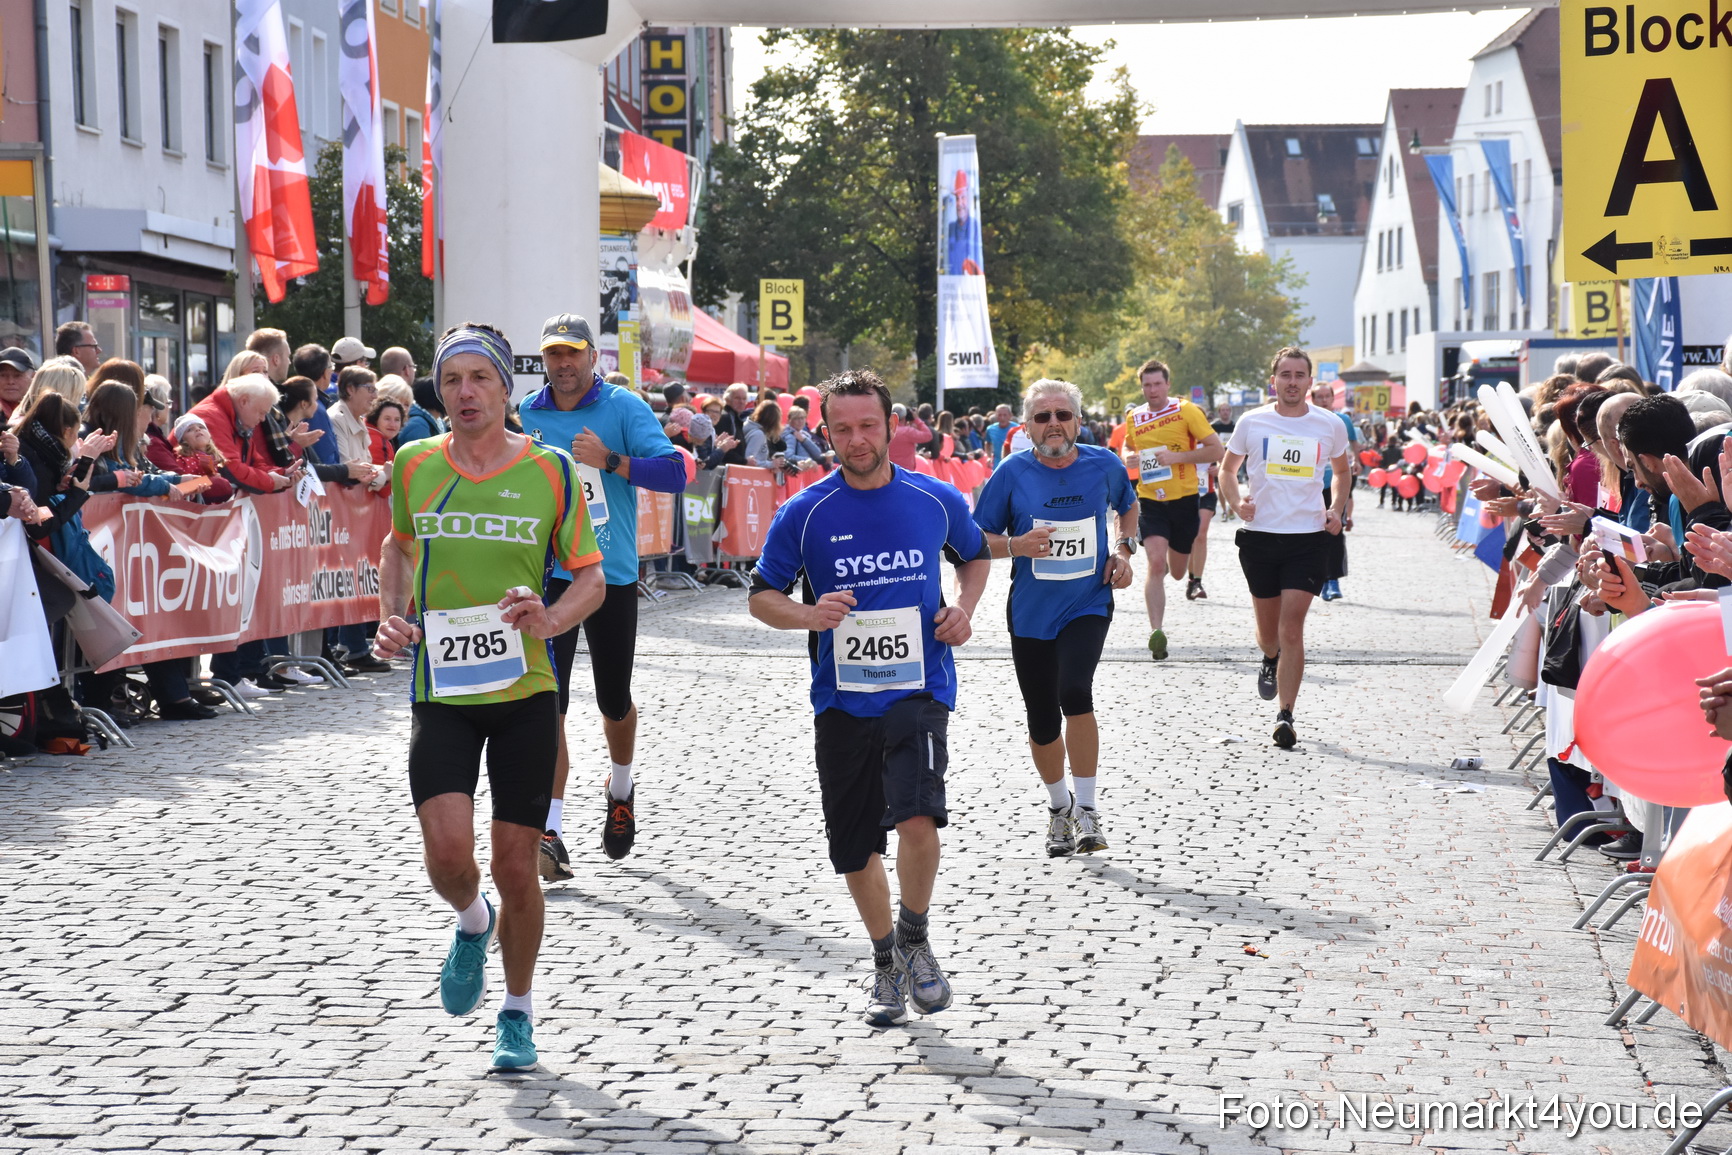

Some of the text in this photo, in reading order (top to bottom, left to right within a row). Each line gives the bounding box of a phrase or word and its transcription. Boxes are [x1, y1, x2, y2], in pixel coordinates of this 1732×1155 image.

[1584, 0, 1732, 57] Block
[1603, 77, 1719, 217] A
[765, 282, 799, 294] Block
[771, 299, 793, 330] B
[1586, 290, 1610, 323] B
[1135, 423, 1157, 437] MAX
[1141, 457, 1161, 471] 262
[1282, 448, 1301, 464] 40
[413, 512, 541, 545] BOCK
[838, 534, 854, 542] JAKO
[834, 549, 925, 578] SYSCAD
[834, 572, 928, 591] www.metallbau-cad.de
[456, 613, 490, 625] BOCK
[864, 617, 897, 627] BOCK
[439, 629, 508, 662] 2785
[845, 633, 910, 661] 2465
[861, 668, 897, 679] Thomas
